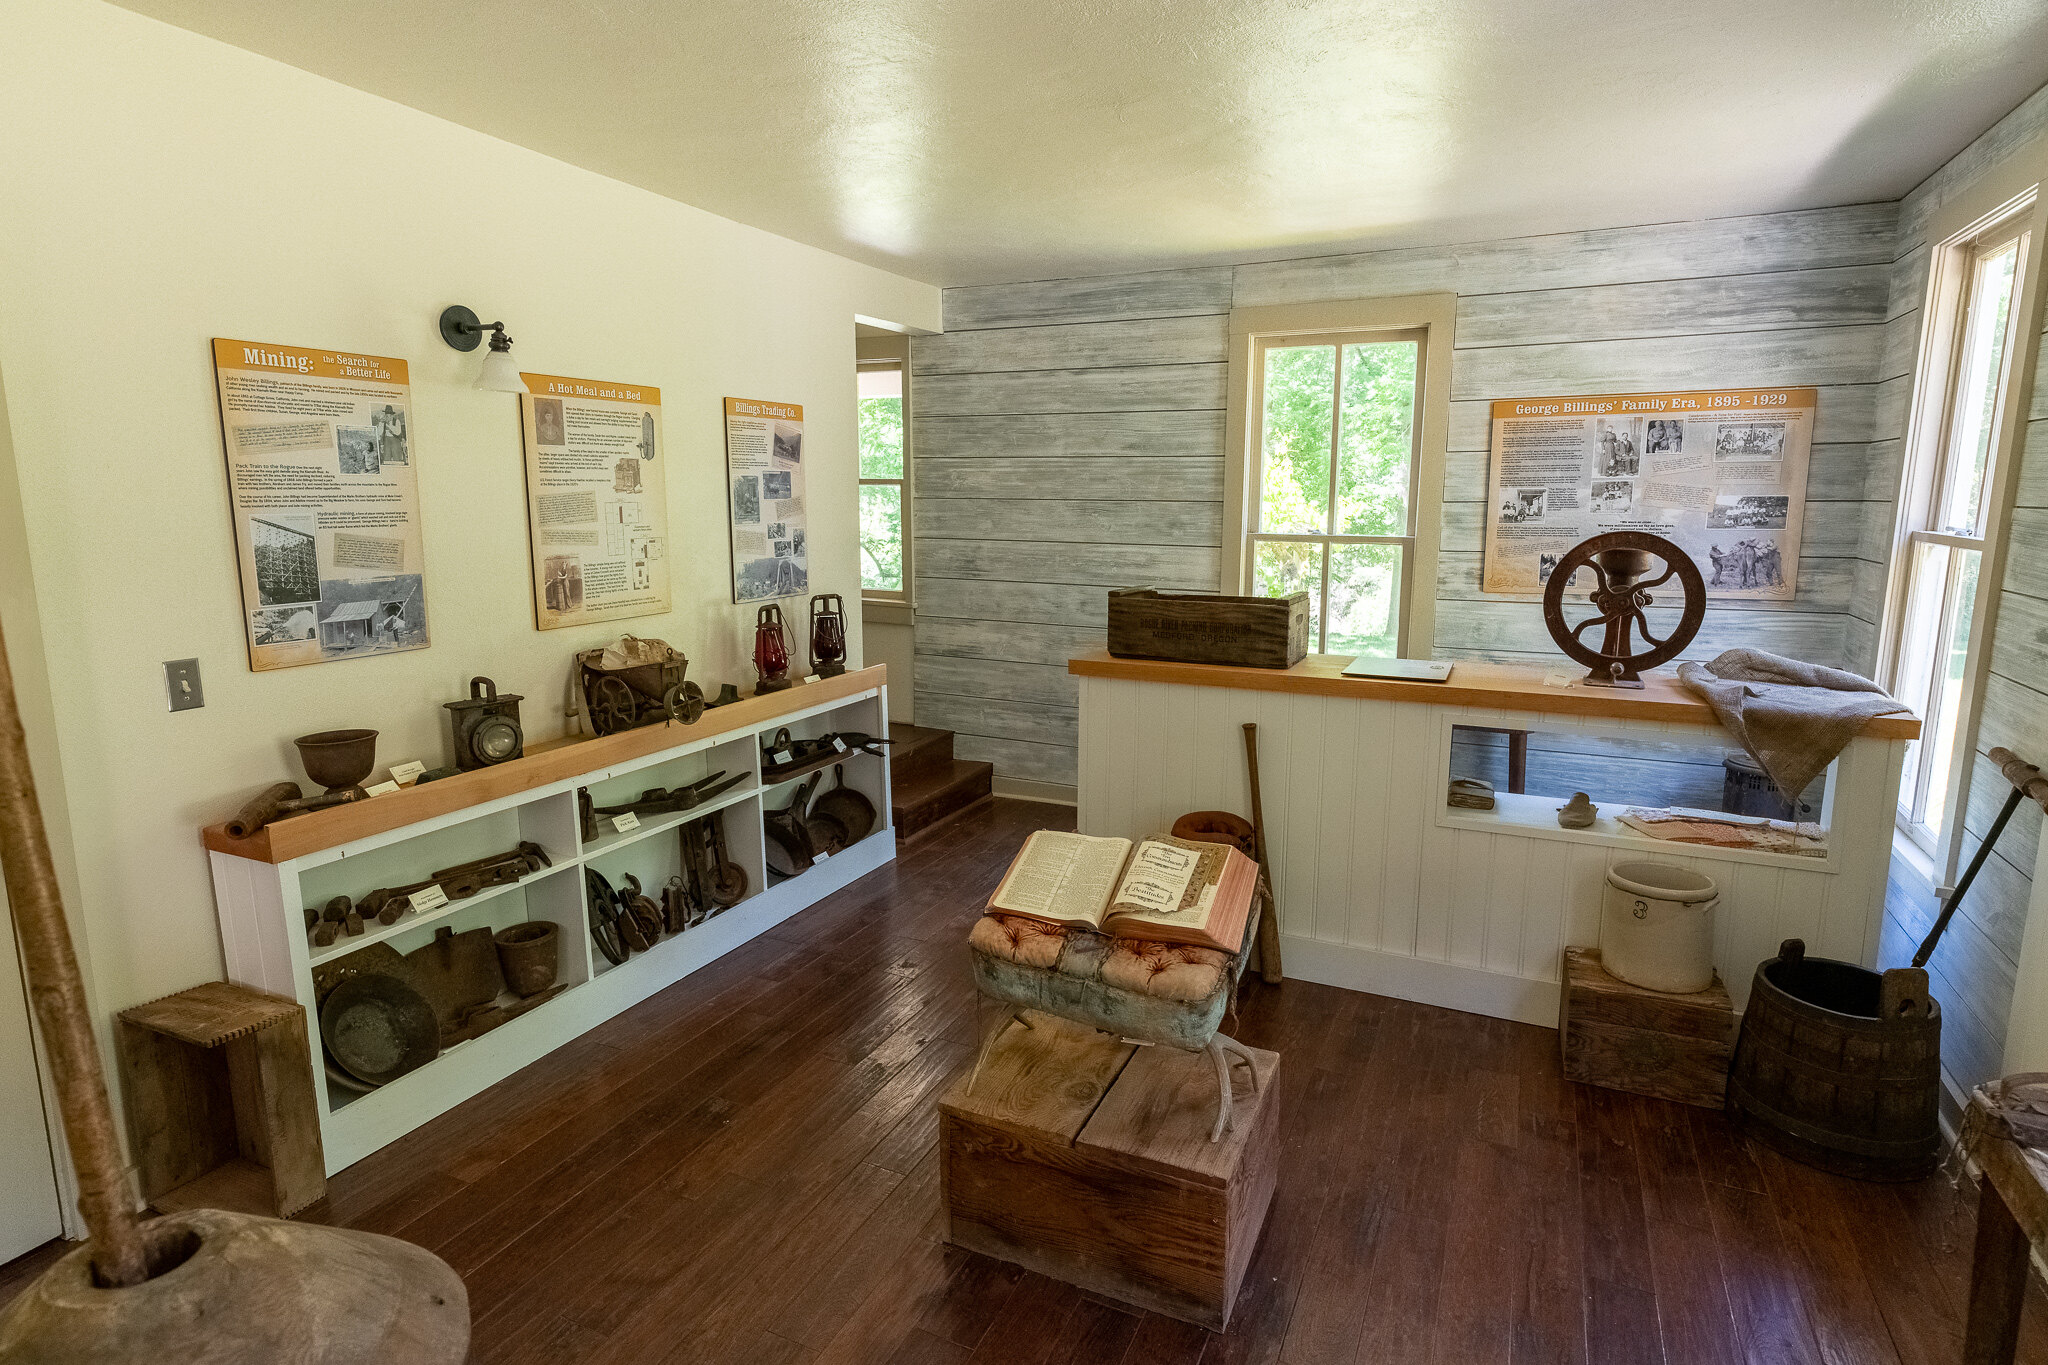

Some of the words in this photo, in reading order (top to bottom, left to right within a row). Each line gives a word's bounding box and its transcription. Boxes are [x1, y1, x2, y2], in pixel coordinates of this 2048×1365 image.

[243, 348, 314, 373] Mining:
[323, 356, 334, 364] the
[337, 355, 368, 367] Search
[346, 366, 372, 378] Better
[375, 369, 390, 380] Life
[548, 383, 555, 392] A
[558, 384, 573, 394] Hot
[576, 385, 597, 396] Meal
[600, 388, 616, 398] and
[626, 390, 641, 401] Bed
[736, 402, 760, 416] Billings
[762, 405, 786, 418] Trading
[787, 408, 796, 417] Co.
[1516, 404, 1559, 416] George
[1564, 401, 1617, 413] Billings'
[1622, 399, 1667, 411] Family
[1671, 398, 1700, 409] Era,
[1707, 396, 1740, 407] 1895
[1152, 631, 1195, 641] MEDFORD
[1201, 634, 1237, 643] OREGON
[1633, 900, 1648, 919] 3
